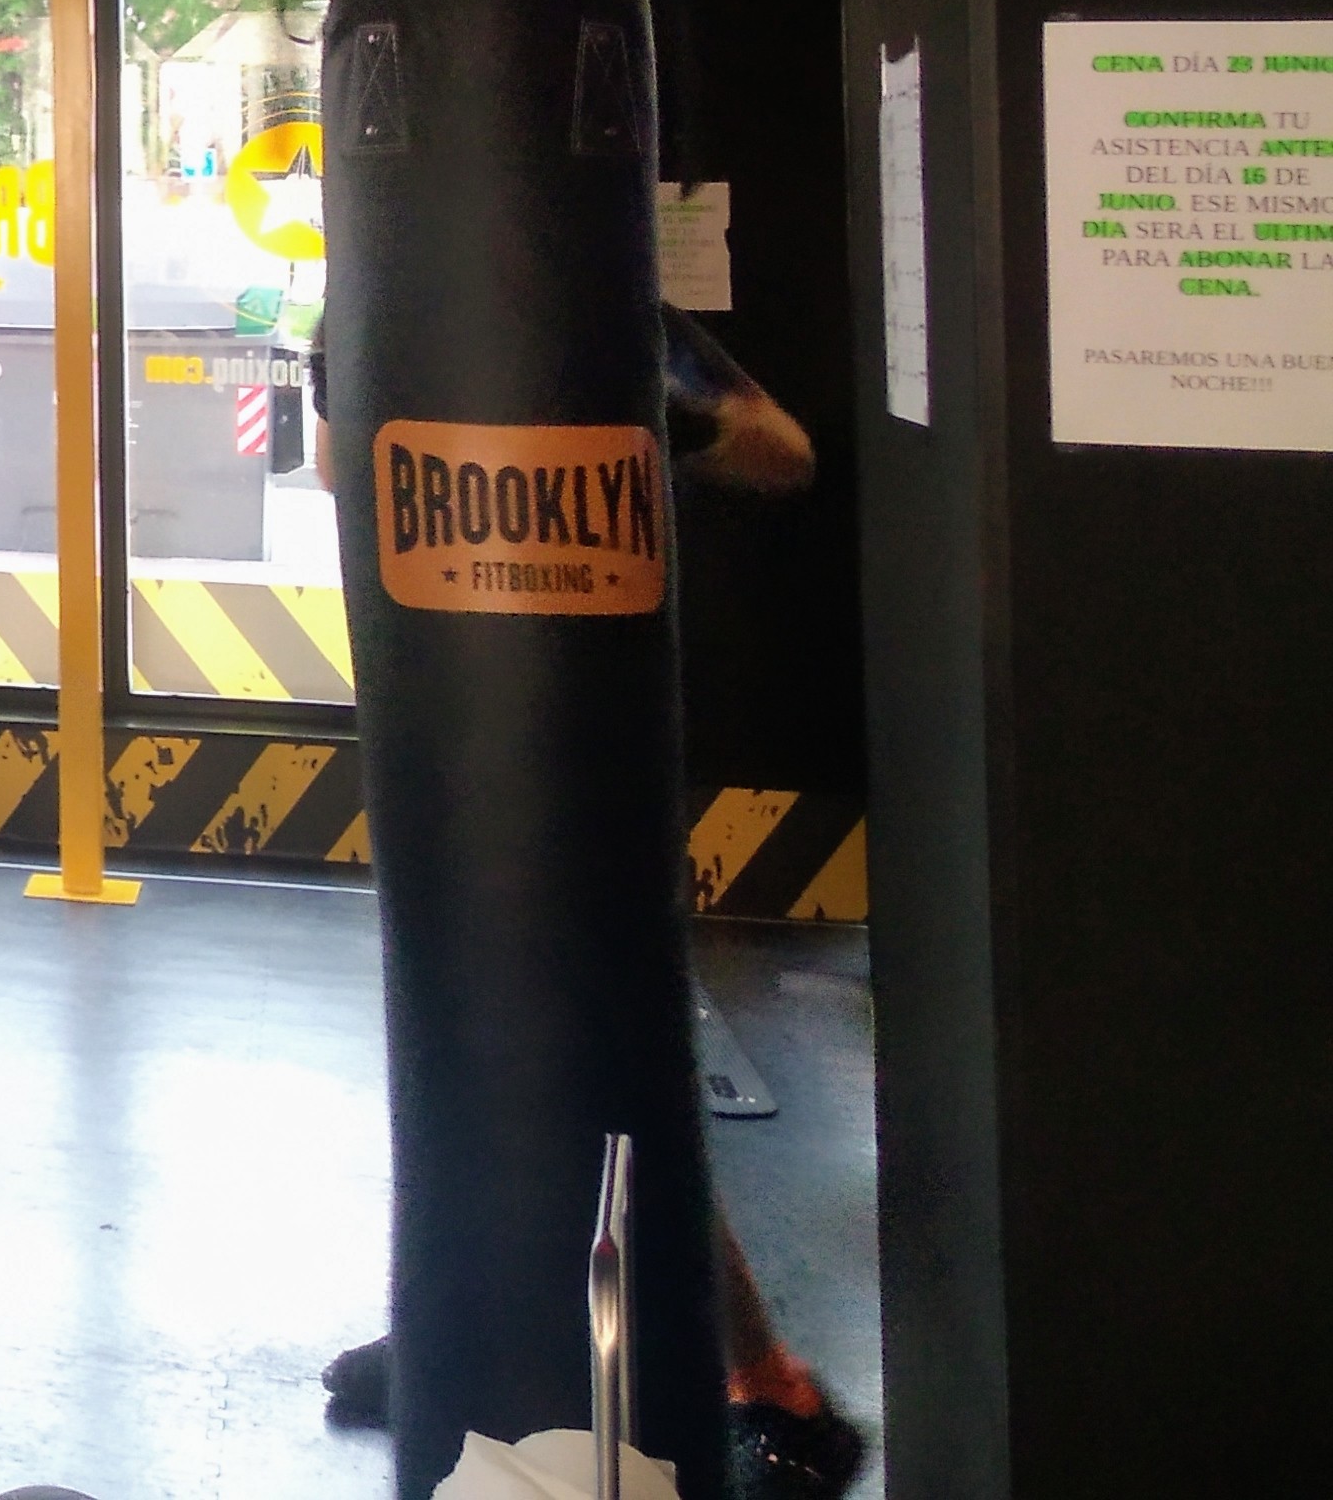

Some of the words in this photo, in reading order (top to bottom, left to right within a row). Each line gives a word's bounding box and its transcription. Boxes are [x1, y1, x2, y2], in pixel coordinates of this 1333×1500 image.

[1092, 55, 1164, 73] CENA
[1173, 52, 1219, 73] DÍA
[1124, 111, 1266, 129] CONFIRMA
[1273, 111, 1310, 130] TU
[1091, 138, 1250, 157] ASISTENCIA
[1258, 139, 1333, 157] ANTE
[1126, 166, 1177, 184] DEL
[1185, 163, 1232, 185] DÍA
[1275, 167, 1310, 186] DE
[1191, 194, 1236, 213] ESE
[1136, 218, 1203, 240] SERÁ
[1213, 222, 1244, 241] EL
[1102, 249, 1171, 267] PARA
[1179, 250, 1292, 269] ABONAR
[1179, 278, 1261, 297] CENA.
[1084, 349, 1219, 367] PASAREMOS
[1226, 352, 1275, 369] UNA
[1171, 374, 1273, 392] NOCHE!!!
[390, 443, 656, 562] BROOKLYN
[472, 561, 595, 594] FITBOXING
